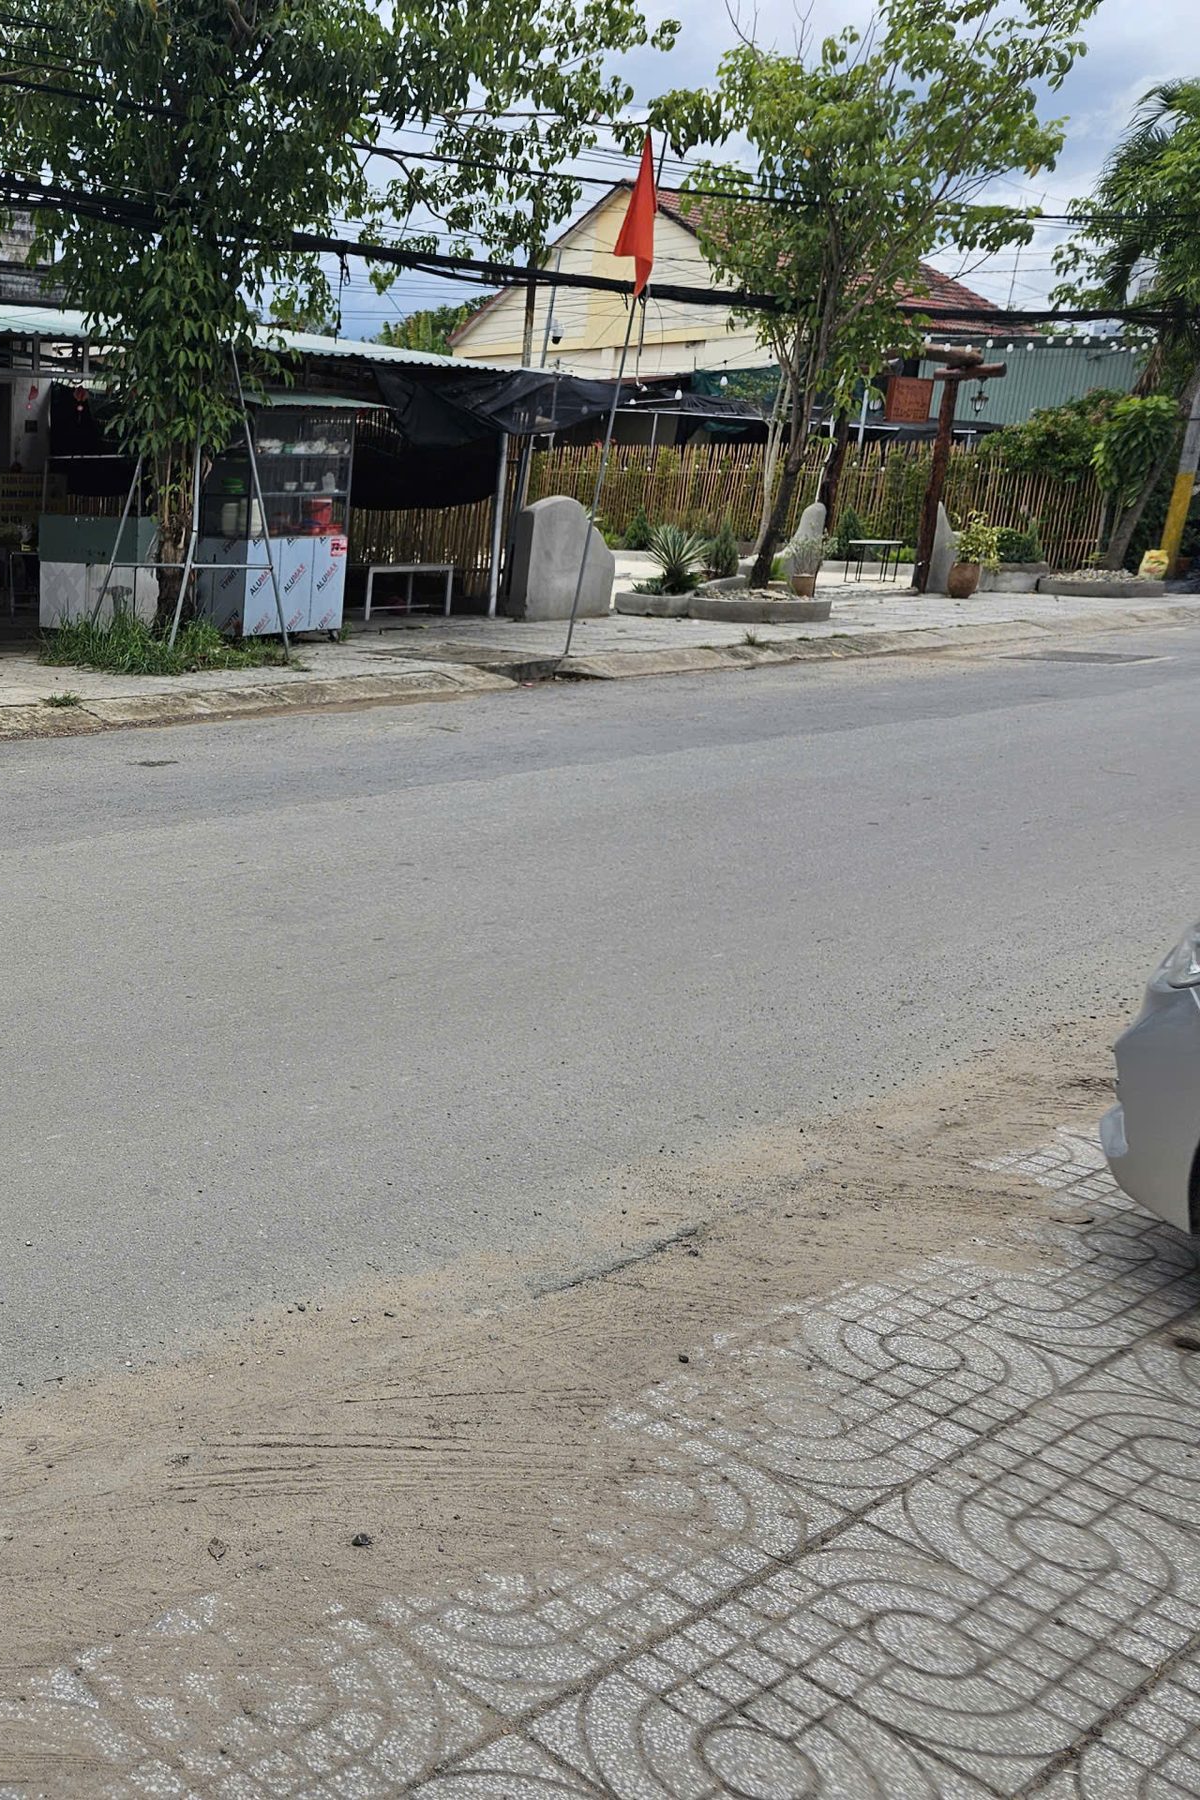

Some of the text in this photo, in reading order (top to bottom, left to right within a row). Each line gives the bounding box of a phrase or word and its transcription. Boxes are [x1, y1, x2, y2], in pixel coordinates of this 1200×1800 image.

[249, 569, 272, 596] ALUMA
[283, 562, 305, 594] ALUMAX
[316, 561, 338, 591] ALUMAX
